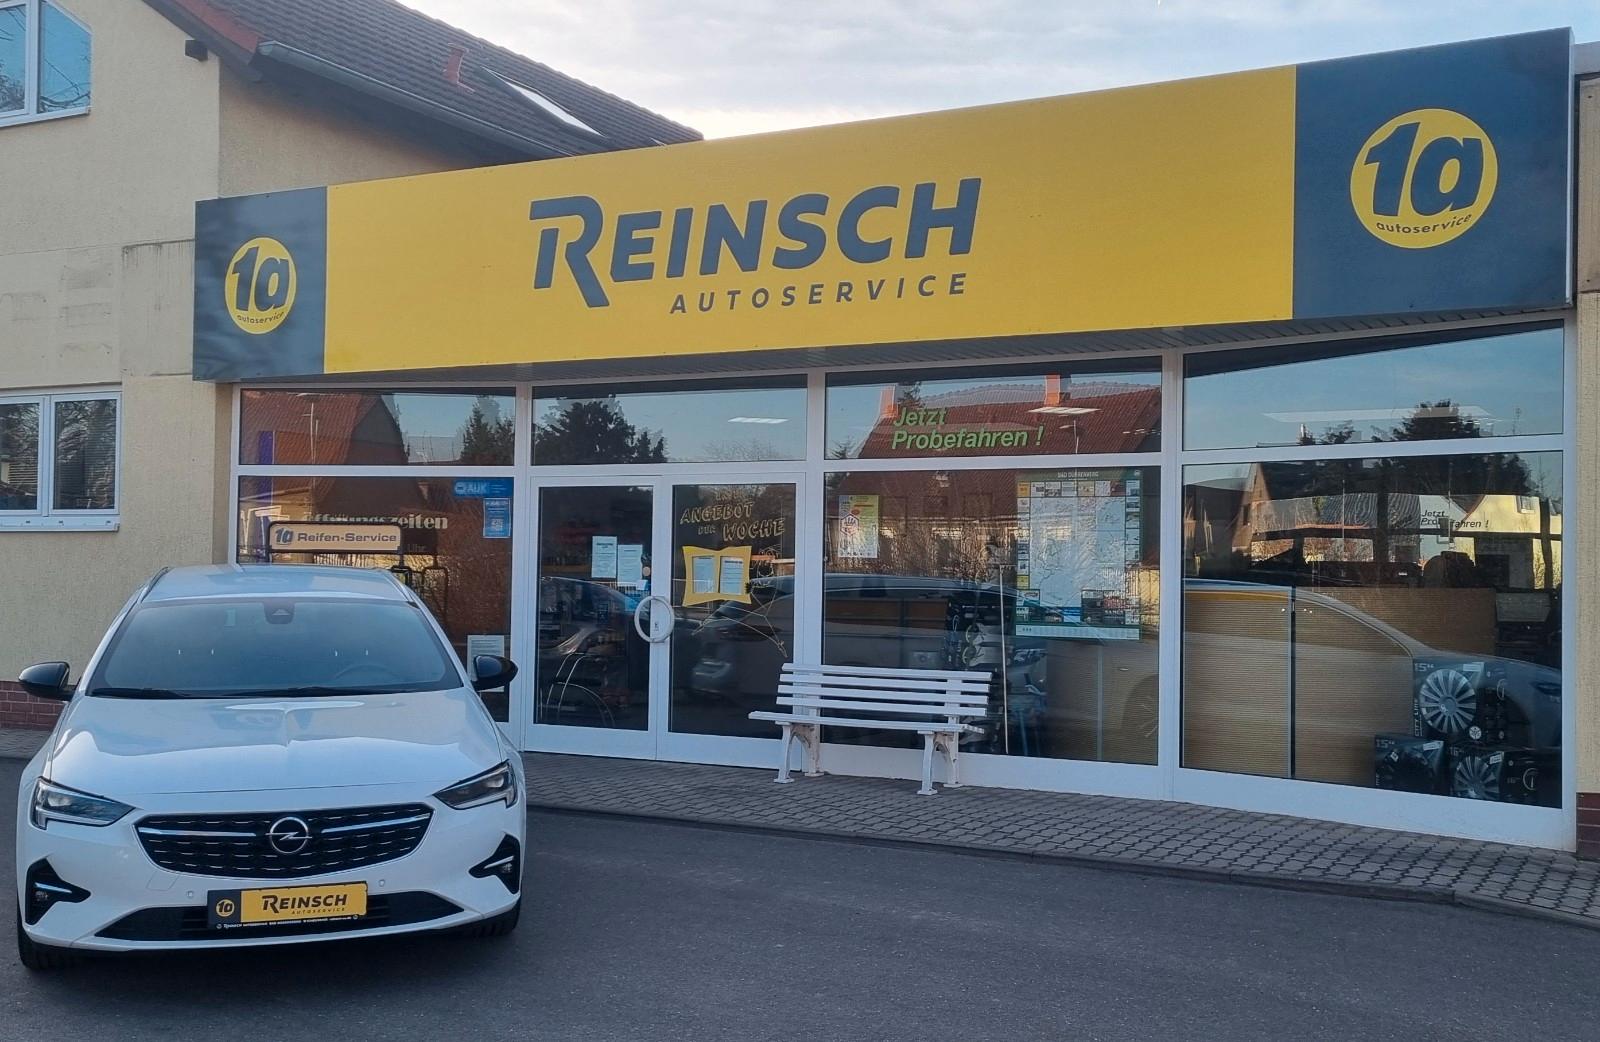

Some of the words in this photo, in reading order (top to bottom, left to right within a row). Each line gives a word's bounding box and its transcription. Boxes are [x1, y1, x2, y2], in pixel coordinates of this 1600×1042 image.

[1364, 122, 1484, 217] 1a
[1376, 212, 1473, 234] autoservice
[529, 177, 982, 308] REINSCH
[231, 246, 289, 311] 1a
[669, 272, 968, 315] AUTOSERVICE
[236, 311, 285, 324] autoservice
[893, 406, 948, 427] Jetzt
[891, 428, 1028, 450] Probefahren
[679, 501, 755, 525] ANGEBOT
[297, 532, 397, 543] Reifen-Service
[722, 518, 786, 542] WOCHE
[261, 893, 348, 914] REINSCH
